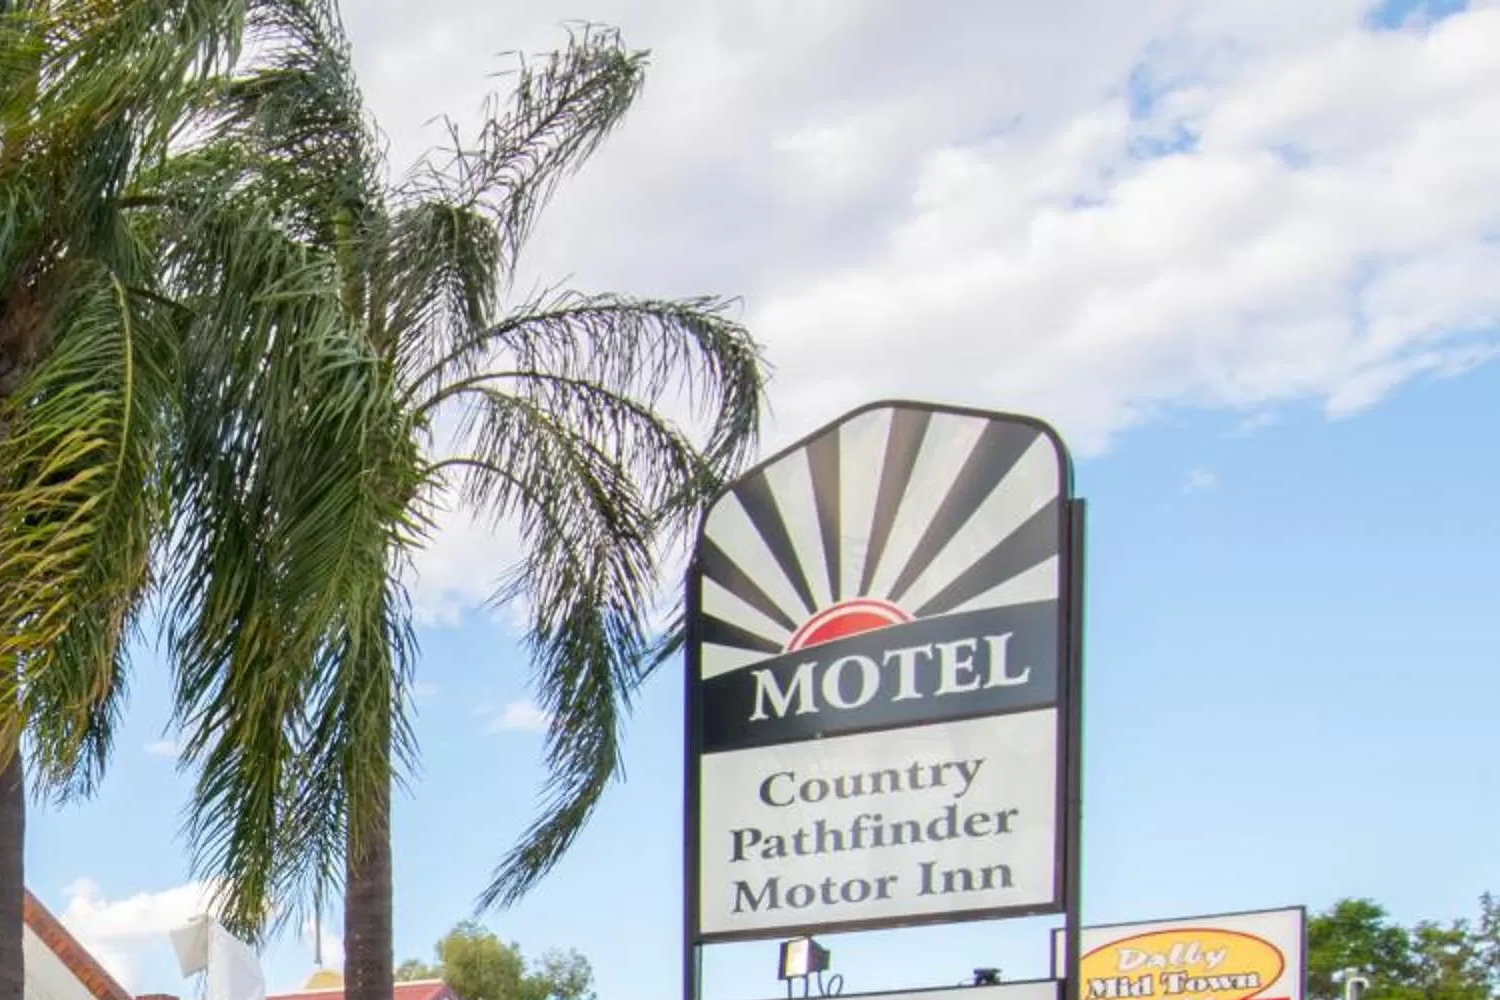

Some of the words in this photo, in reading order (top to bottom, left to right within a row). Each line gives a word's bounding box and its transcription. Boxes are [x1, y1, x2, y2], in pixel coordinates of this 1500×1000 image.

[749, 632, 1031, 722] MOTEL
[759, 756, 987, 808] Country
[728, 804, 1020, 863] Pathfinder
[731, 873, 899, 914] Motor
[916, 860, 1014, 897] Inn
[1117, 941, 1228, 972] Dalby
[1085, 974, 1155, 1000] Mid
[1160, 970, 1262, 995] Town
